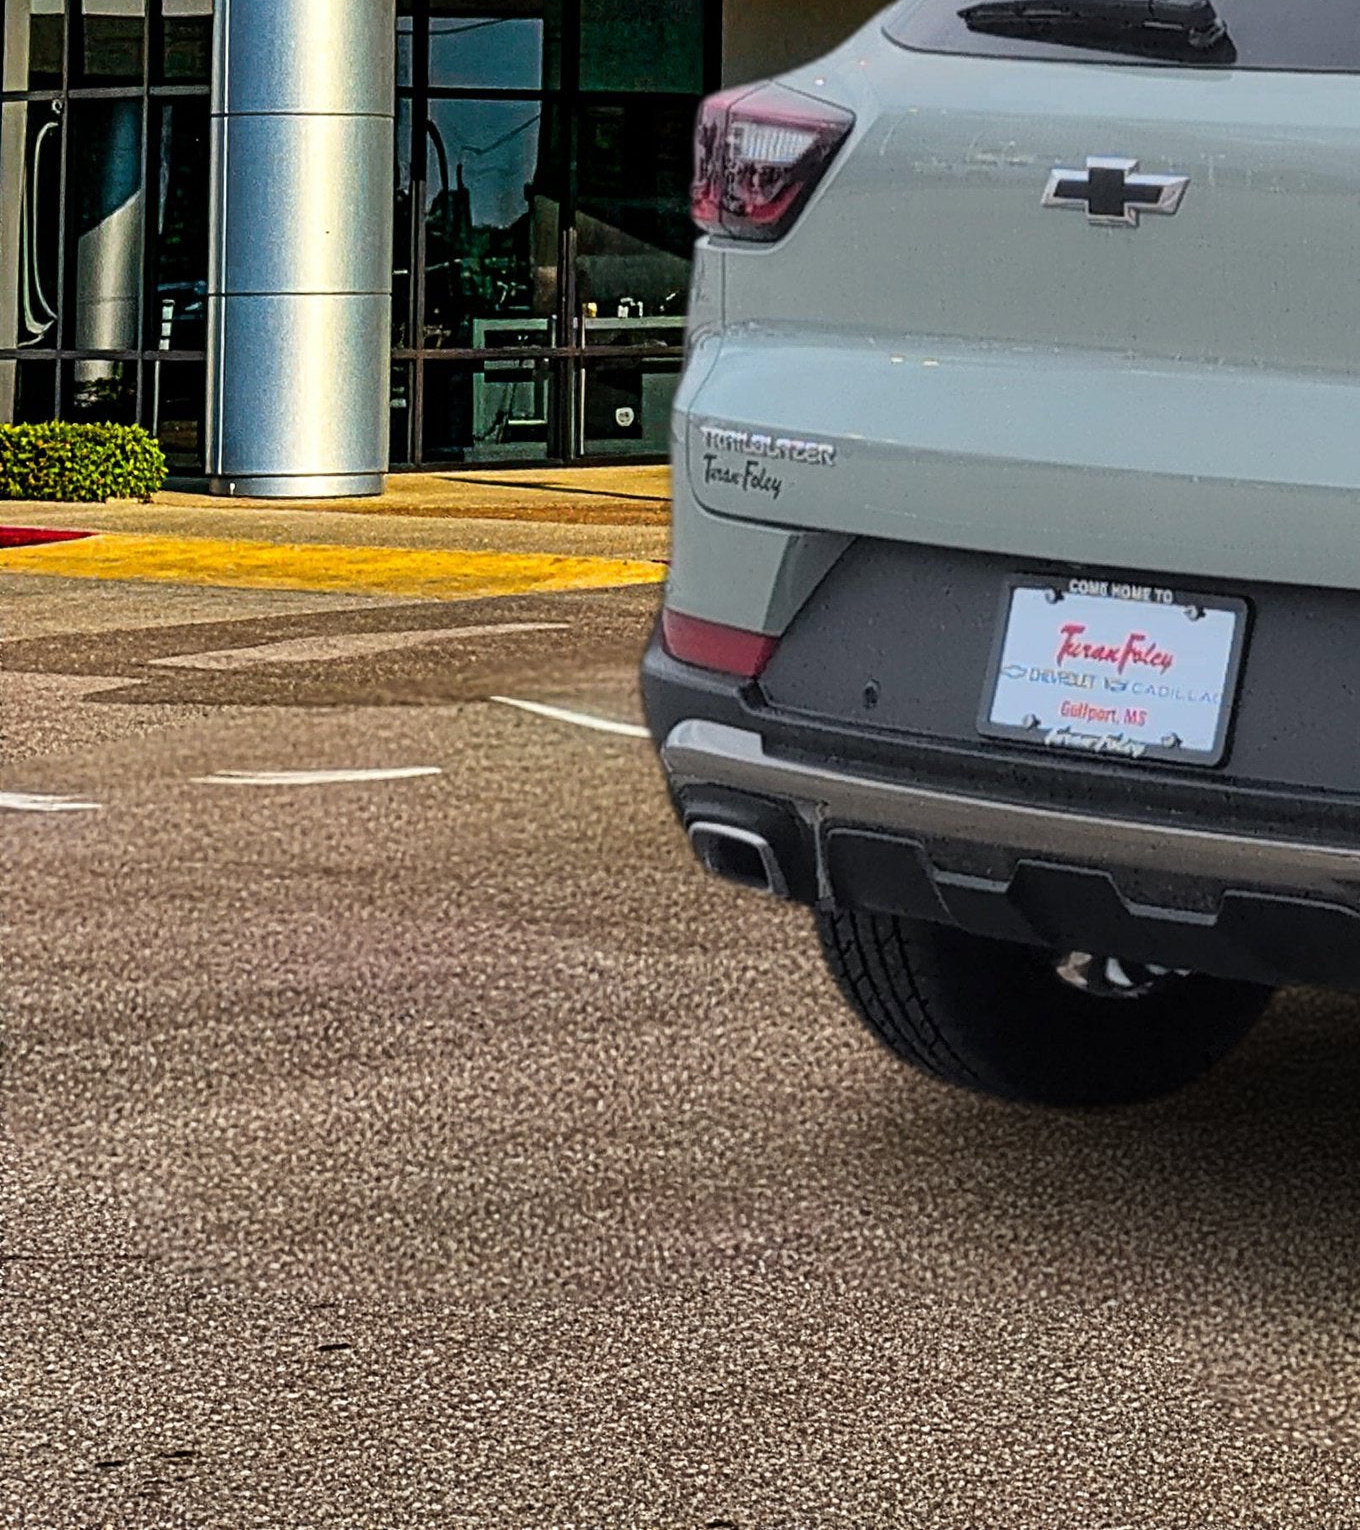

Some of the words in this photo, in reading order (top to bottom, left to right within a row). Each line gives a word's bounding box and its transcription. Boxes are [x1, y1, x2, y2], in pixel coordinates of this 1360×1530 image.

[1068, 578, 1109, 598] COME
[1110, 583, 1152, 601] HOME
[1154, 588, 1174, 604] TO
[1122, 708, 1148, 727] MS
